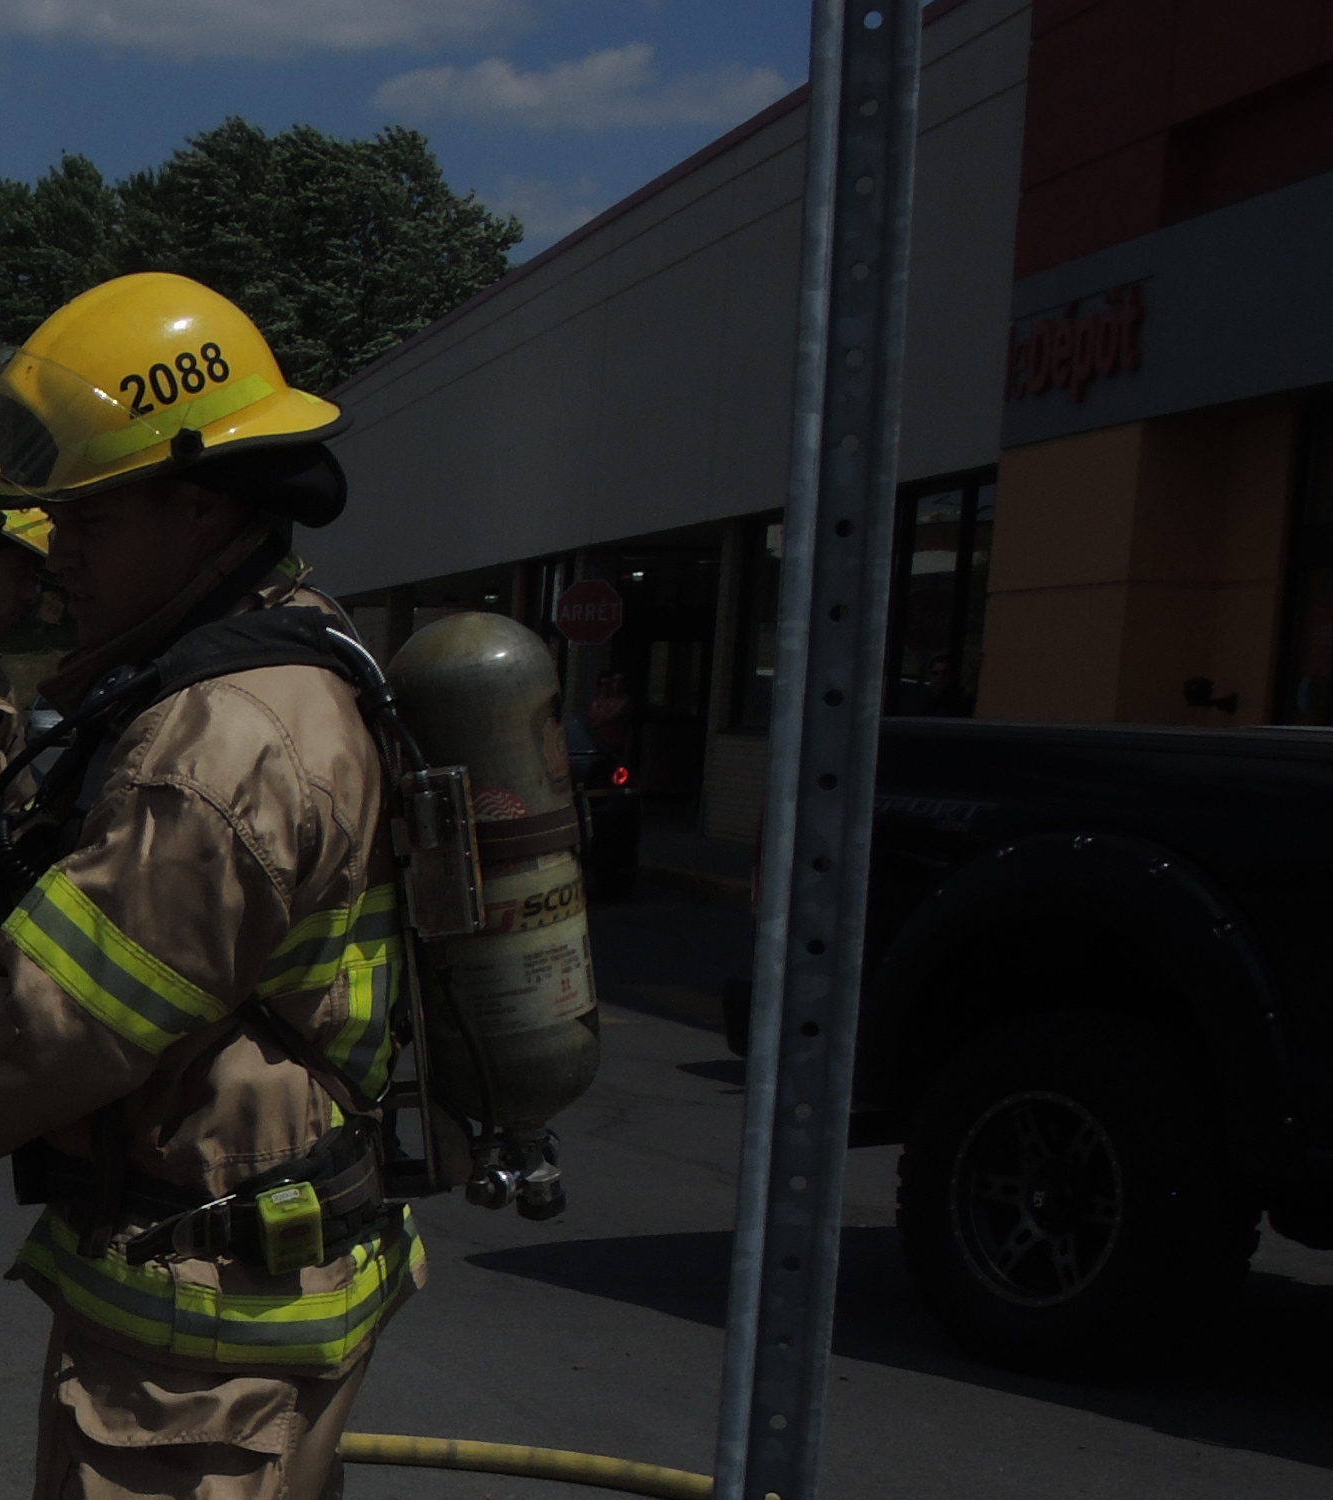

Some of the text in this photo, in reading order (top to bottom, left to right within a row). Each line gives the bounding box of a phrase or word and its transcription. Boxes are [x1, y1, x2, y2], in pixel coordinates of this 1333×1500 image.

[120, 342, 229, 419] 2088
[561, 600, 619, 622] ARRÊT
[874, 793, 997, 822] PORT
